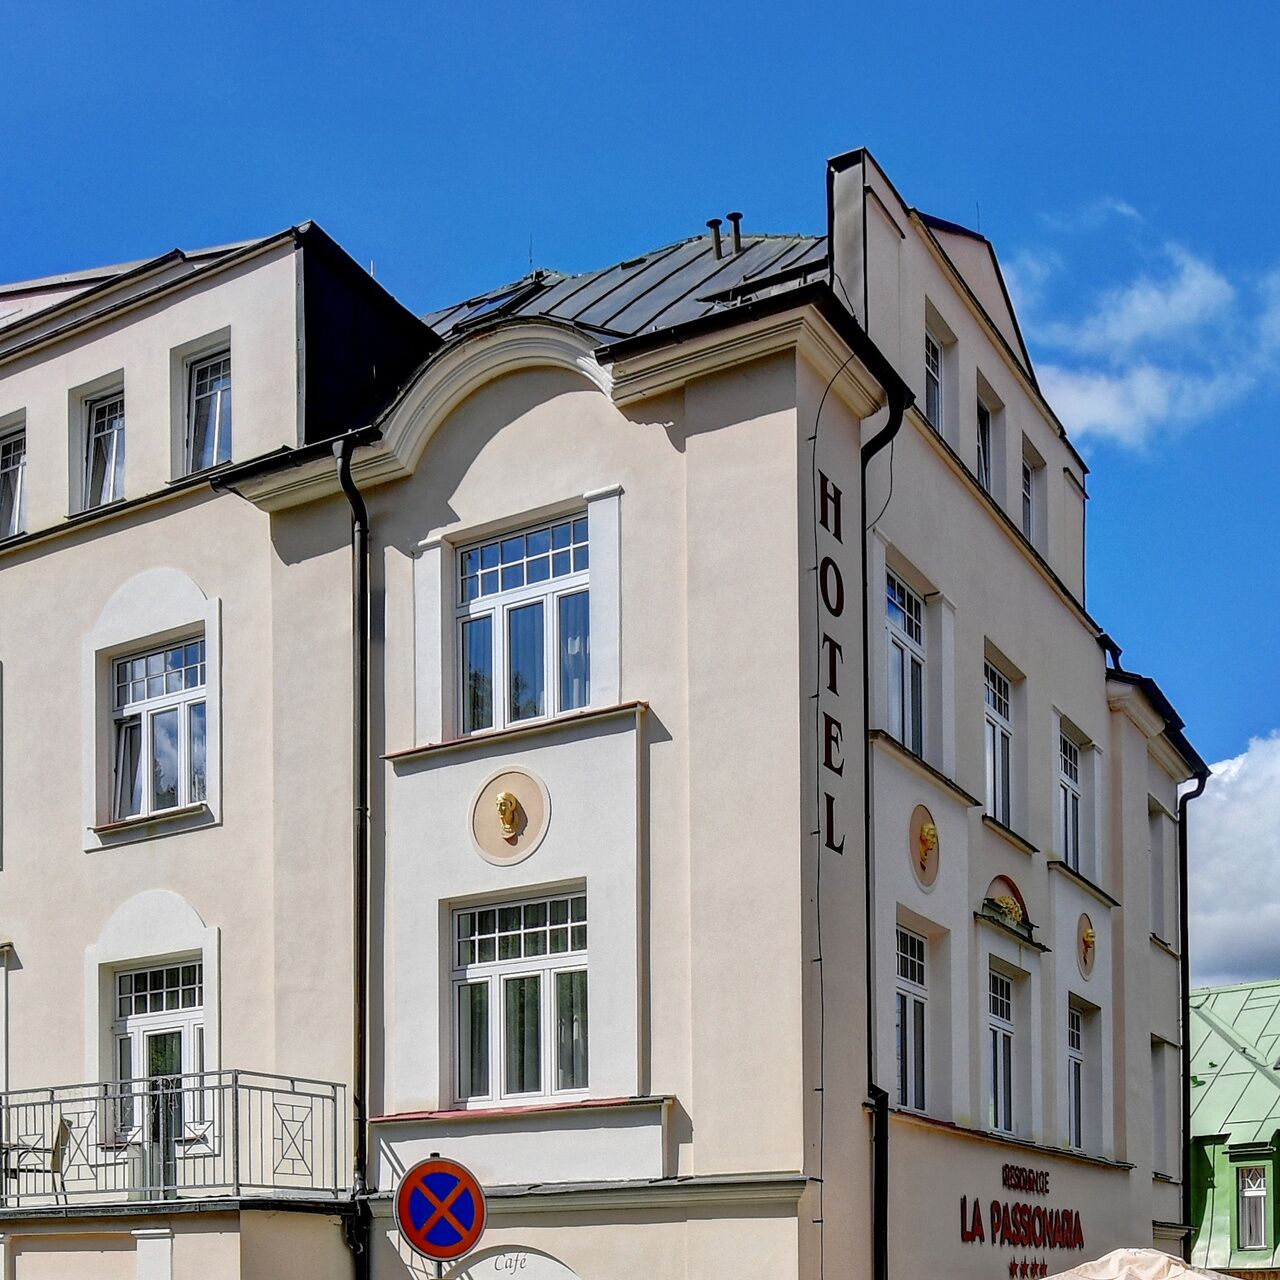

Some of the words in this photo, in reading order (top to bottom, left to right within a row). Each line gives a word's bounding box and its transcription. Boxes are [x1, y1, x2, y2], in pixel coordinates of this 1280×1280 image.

[818, 469, 845, 856] HOTEL
[1002, 1163, 1050, 1196] RESIDENCE
[960, 1194, 985, 1244] LA
[990, 1199, 1084, 1250] PASSIONARIA
[494, 1251, 528, 1275] Café
